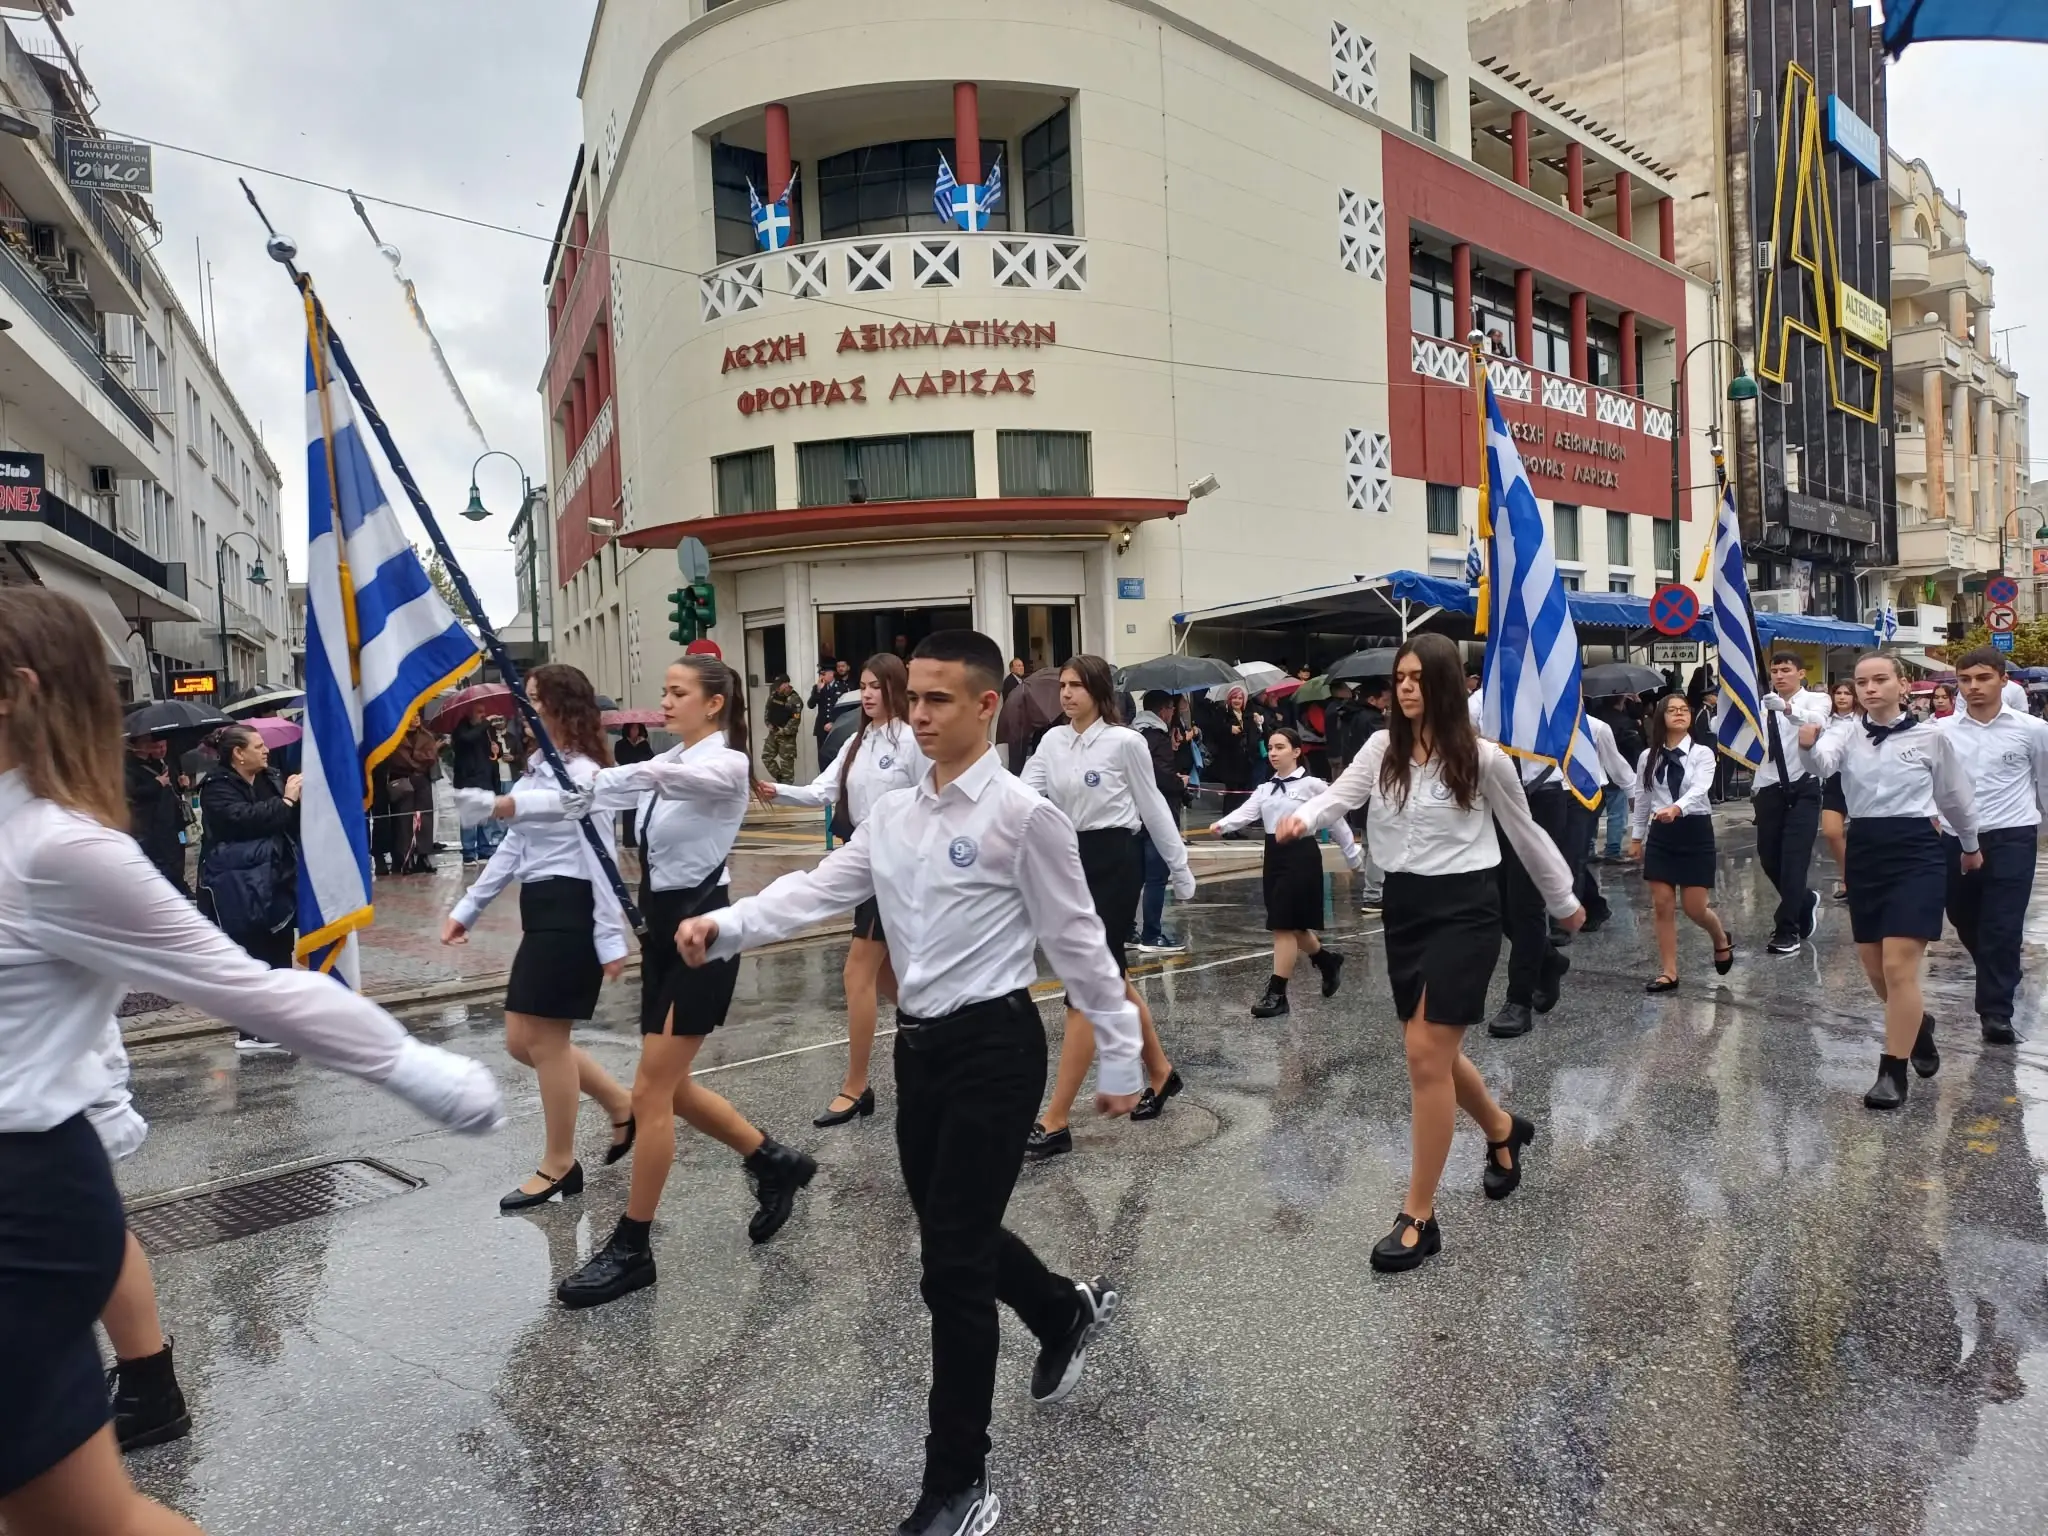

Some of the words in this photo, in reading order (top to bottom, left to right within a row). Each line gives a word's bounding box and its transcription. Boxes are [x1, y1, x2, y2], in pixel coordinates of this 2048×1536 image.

[1846, 292, 1884, 332] ALTERLIFE
[721, 332, 807, 375] ΛΕΣΧΗ
[836, 318, 1056, 354] ΑΞΙΩΜΑΤΙΚΩΝ
[737, 375, 867, 415] ΦΡΟΥΡΑΣ
[889, 368, 1036, 400] ΛΑΡΙΣΑΣ
[1554, 430, 1627, 462] ΑΞΙΩΜΑΤΙΚΩΝ
[1574, 463, 1620, 489] ΛΑΡΙΣΑΣ
[1662, 651, 1694, 659] ΛΑΦΛ
